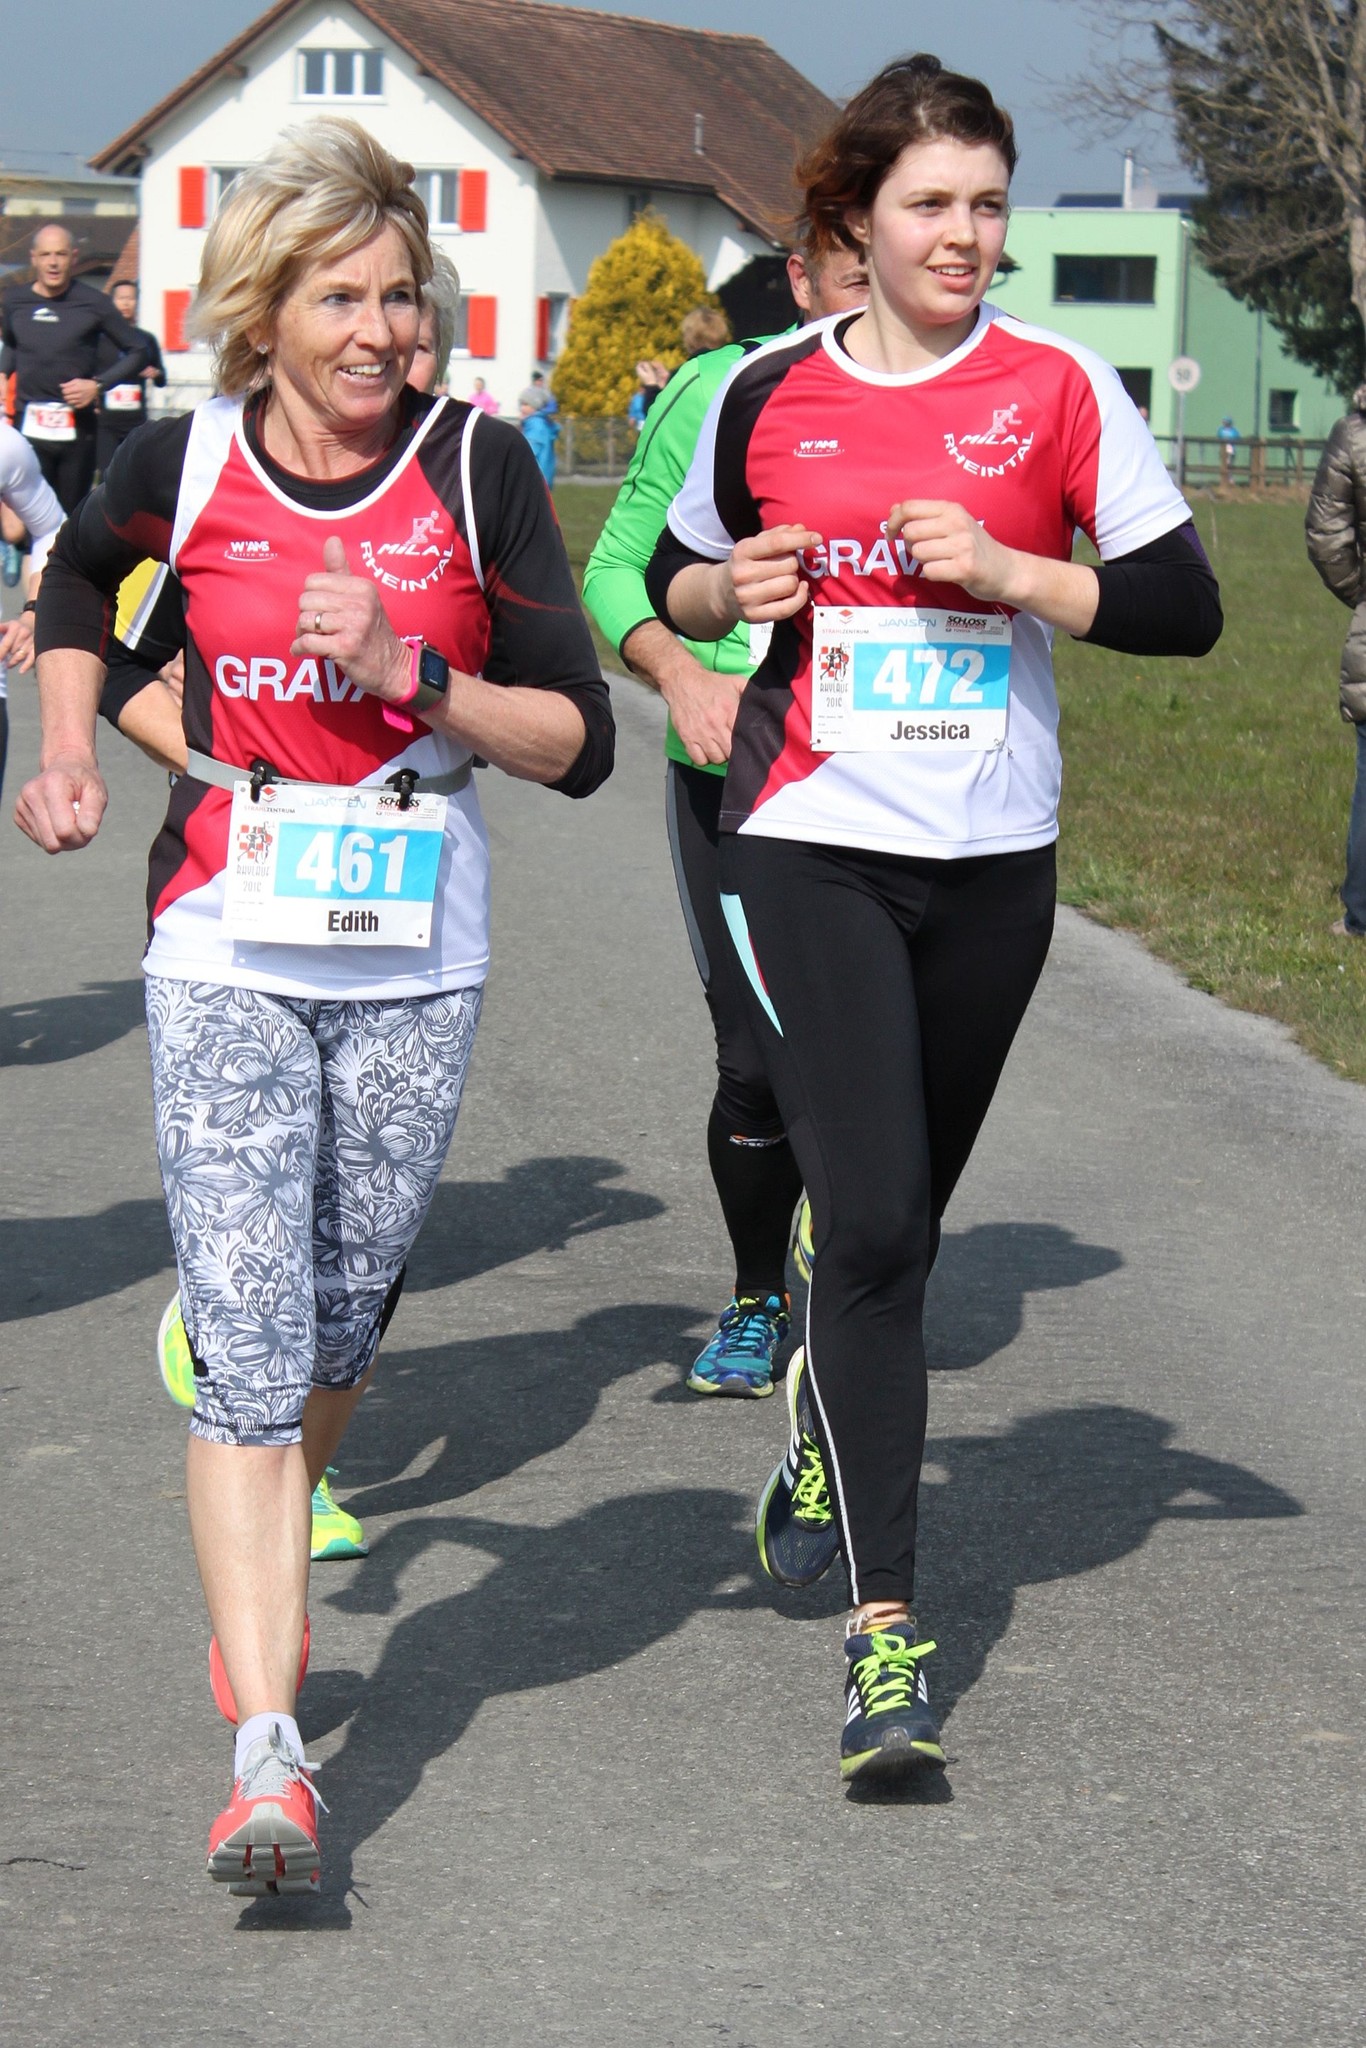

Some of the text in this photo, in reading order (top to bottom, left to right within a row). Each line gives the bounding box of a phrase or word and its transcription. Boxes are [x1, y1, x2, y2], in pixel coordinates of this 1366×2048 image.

[943, 431, 1034, 478] RHEINTAL
[360, 540, 454, 593] RHEINTAL
[796, 538, 930, 579] GRAV
[878, 618, 937, 628] JANSEN
[948, 615, 988, 626] SCHLOSS
[215, 654, 366, 703] GRAV
[873, 649, 985, 705] 472
[890, 720, 970, 740] Jessica
[296, 831, 408, 894] 461
[327, 909, 379, 932] Edith
